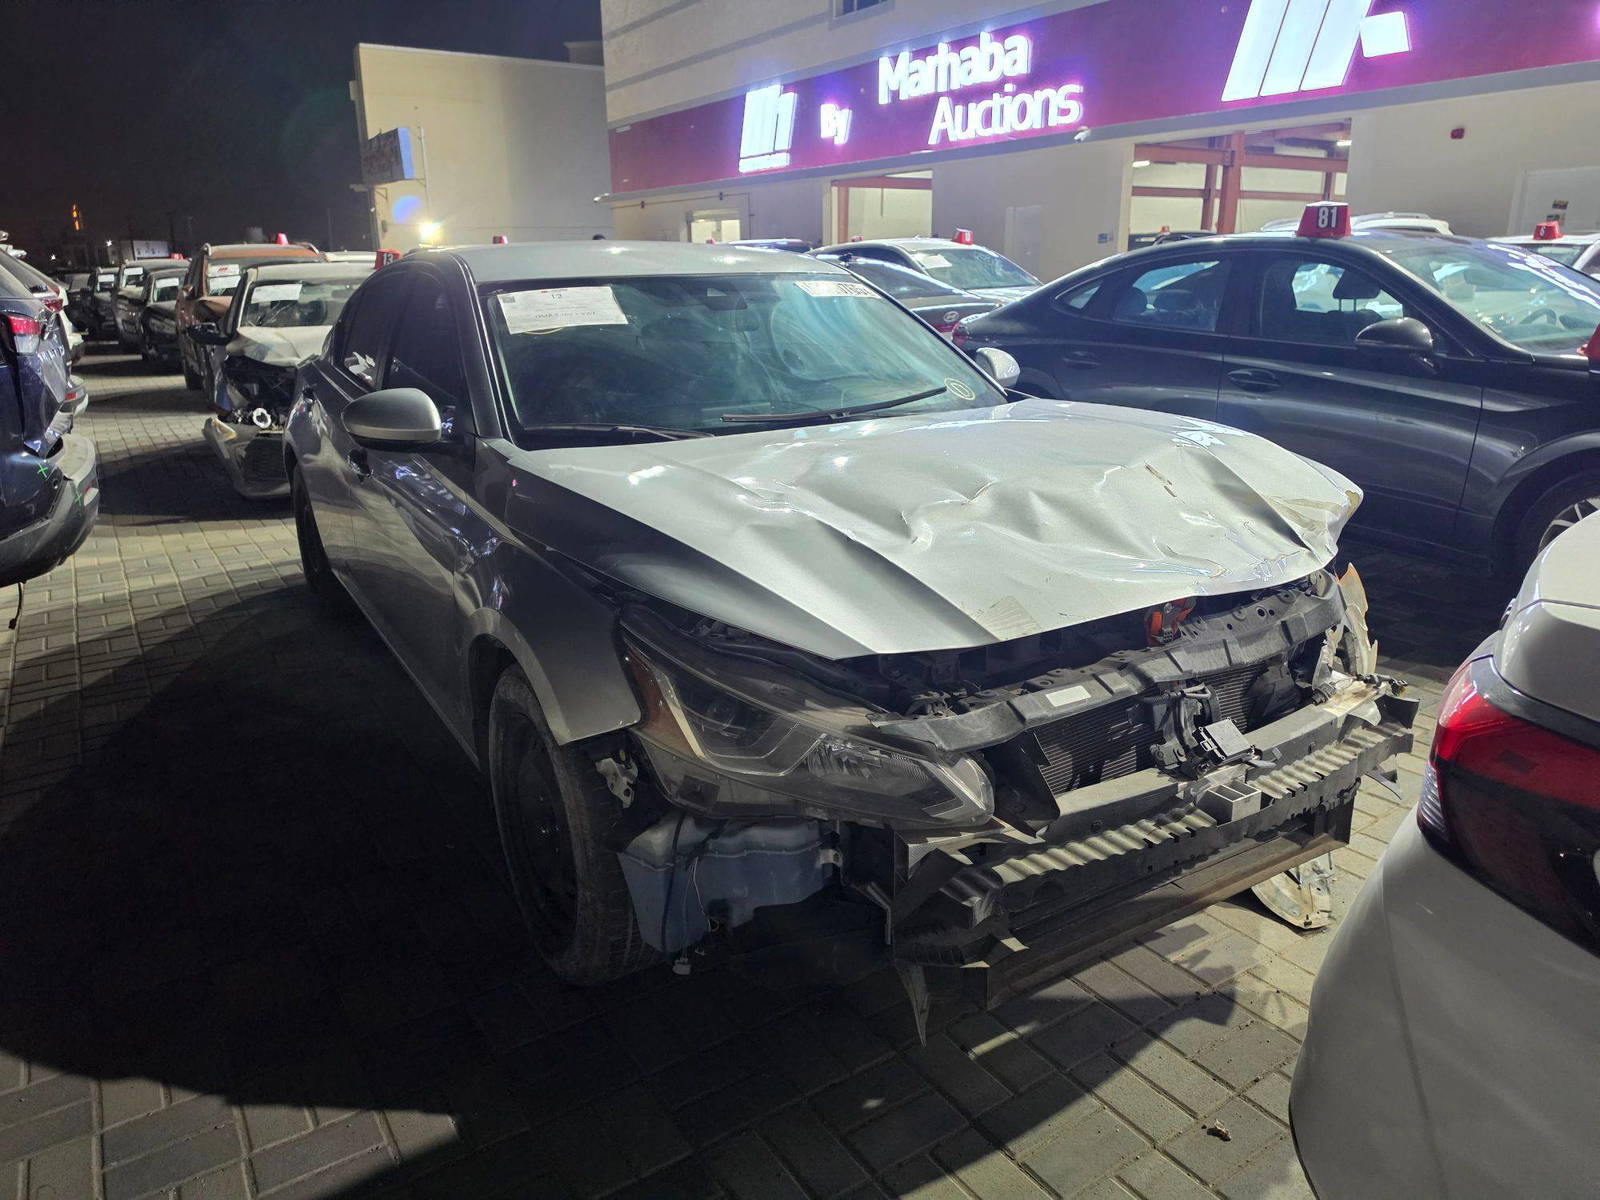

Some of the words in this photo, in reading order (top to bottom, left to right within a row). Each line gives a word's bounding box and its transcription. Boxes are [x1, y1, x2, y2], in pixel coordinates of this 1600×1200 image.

[878, 31, 1032, 105] Marhaba
[820, 103, 852, 145] By
[928, 83, 1083, 145] Auctions
[1318, 206, 1338, 229] 81
